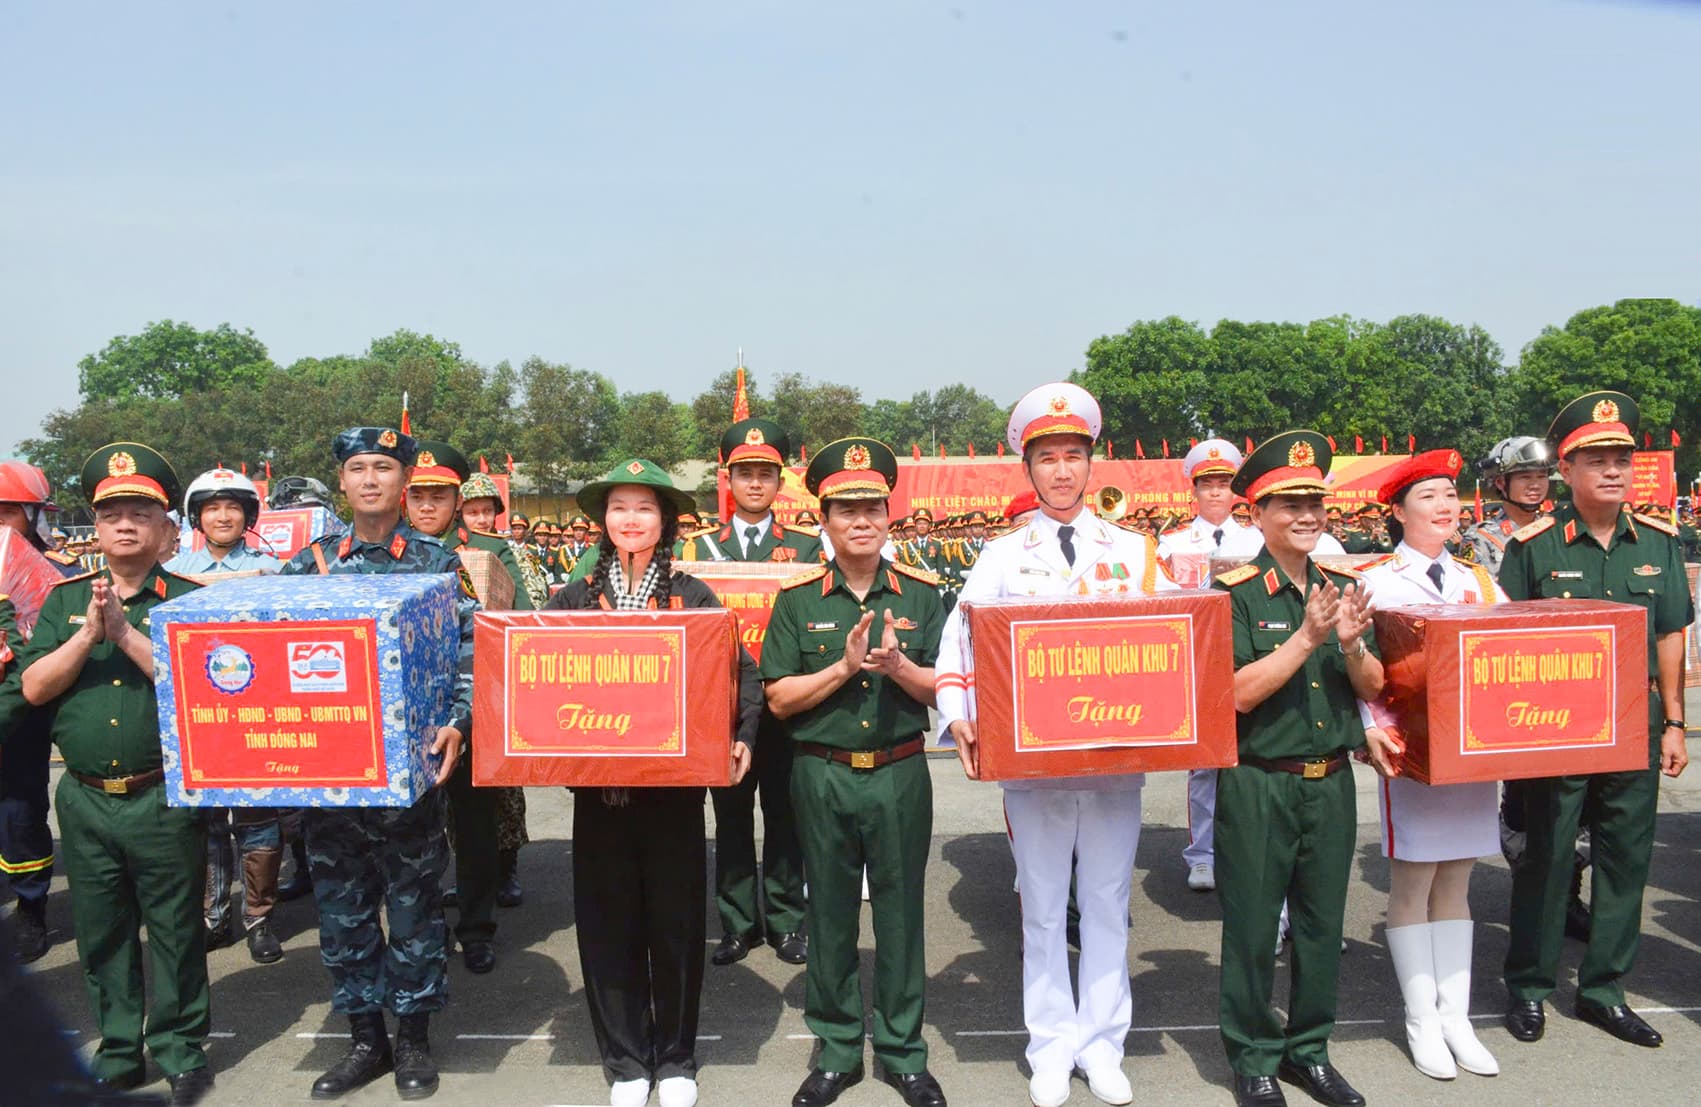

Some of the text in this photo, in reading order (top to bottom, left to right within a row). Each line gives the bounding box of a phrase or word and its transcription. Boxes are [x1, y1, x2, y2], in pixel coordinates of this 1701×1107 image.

[519, 647, 671, 690] BỘ TƯ LỆNH QUÂN KHU 7
[1027, 639, 1179, 684] BỘ TƯ LỆNH QUÂN KHU 7
[1473, 647, 1603, 690] BỘ TƯ LỆNH QUÂN KHU 7
[191, 703, 215, 723] TỈNH
[216, 702, 229, 723] ỦY
[238, 706, 266, 723] HĐND
[274, 706, 301, 722] UBND
[310, 705, 351, 724] UBMTTQ
[353, 705, 367, 721] VN
[557, 703, 633, 737] Tặng
[1067, 695, 1144, 728] Tặng
[1506, 701, 1571, 731] Tặng
[244, 727, 317, 749] TỈNH ĐỒNG NAI
[264, 761, 300, 774] Tặng
